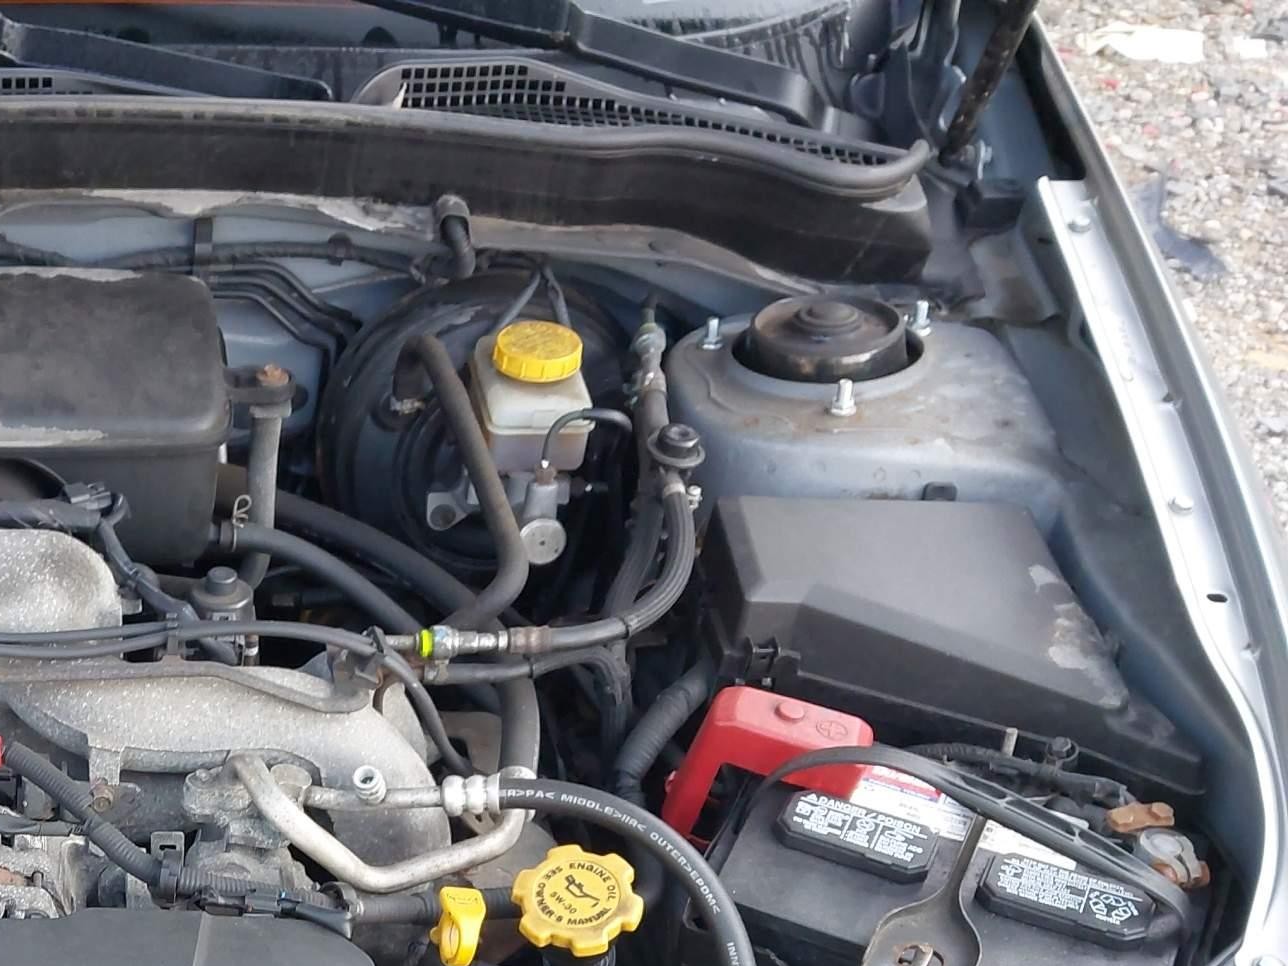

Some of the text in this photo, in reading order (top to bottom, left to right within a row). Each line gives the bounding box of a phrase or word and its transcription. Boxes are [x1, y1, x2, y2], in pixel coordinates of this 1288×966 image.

[569, 863, 617, 901] ENGINE OIL
[549, 891, 578, 914] 5W-30
